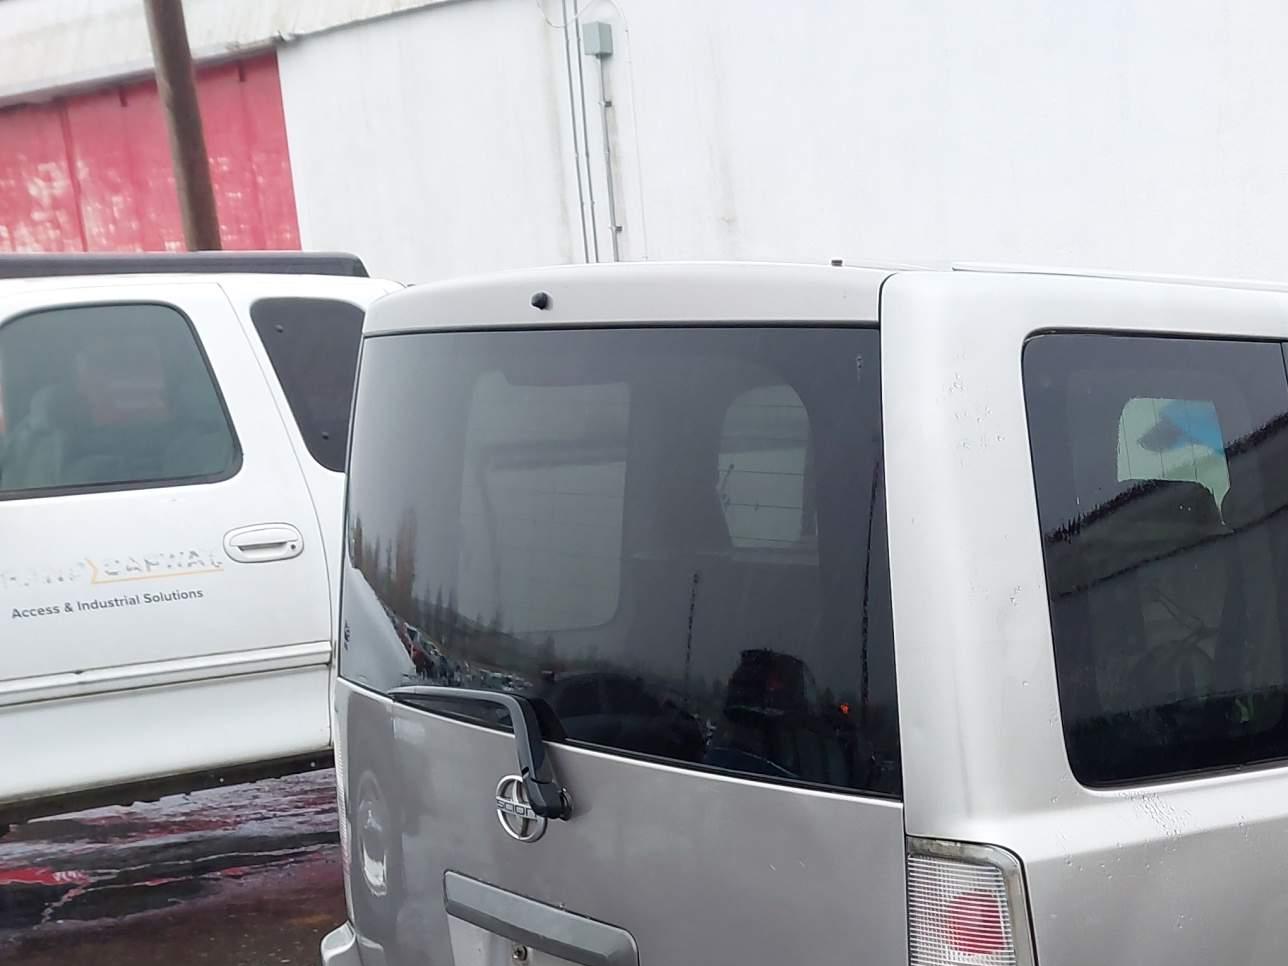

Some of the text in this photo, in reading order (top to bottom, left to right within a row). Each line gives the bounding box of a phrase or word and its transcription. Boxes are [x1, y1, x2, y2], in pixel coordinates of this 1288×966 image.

[11, 589, 204, 619] Access & Industrial Solutions
